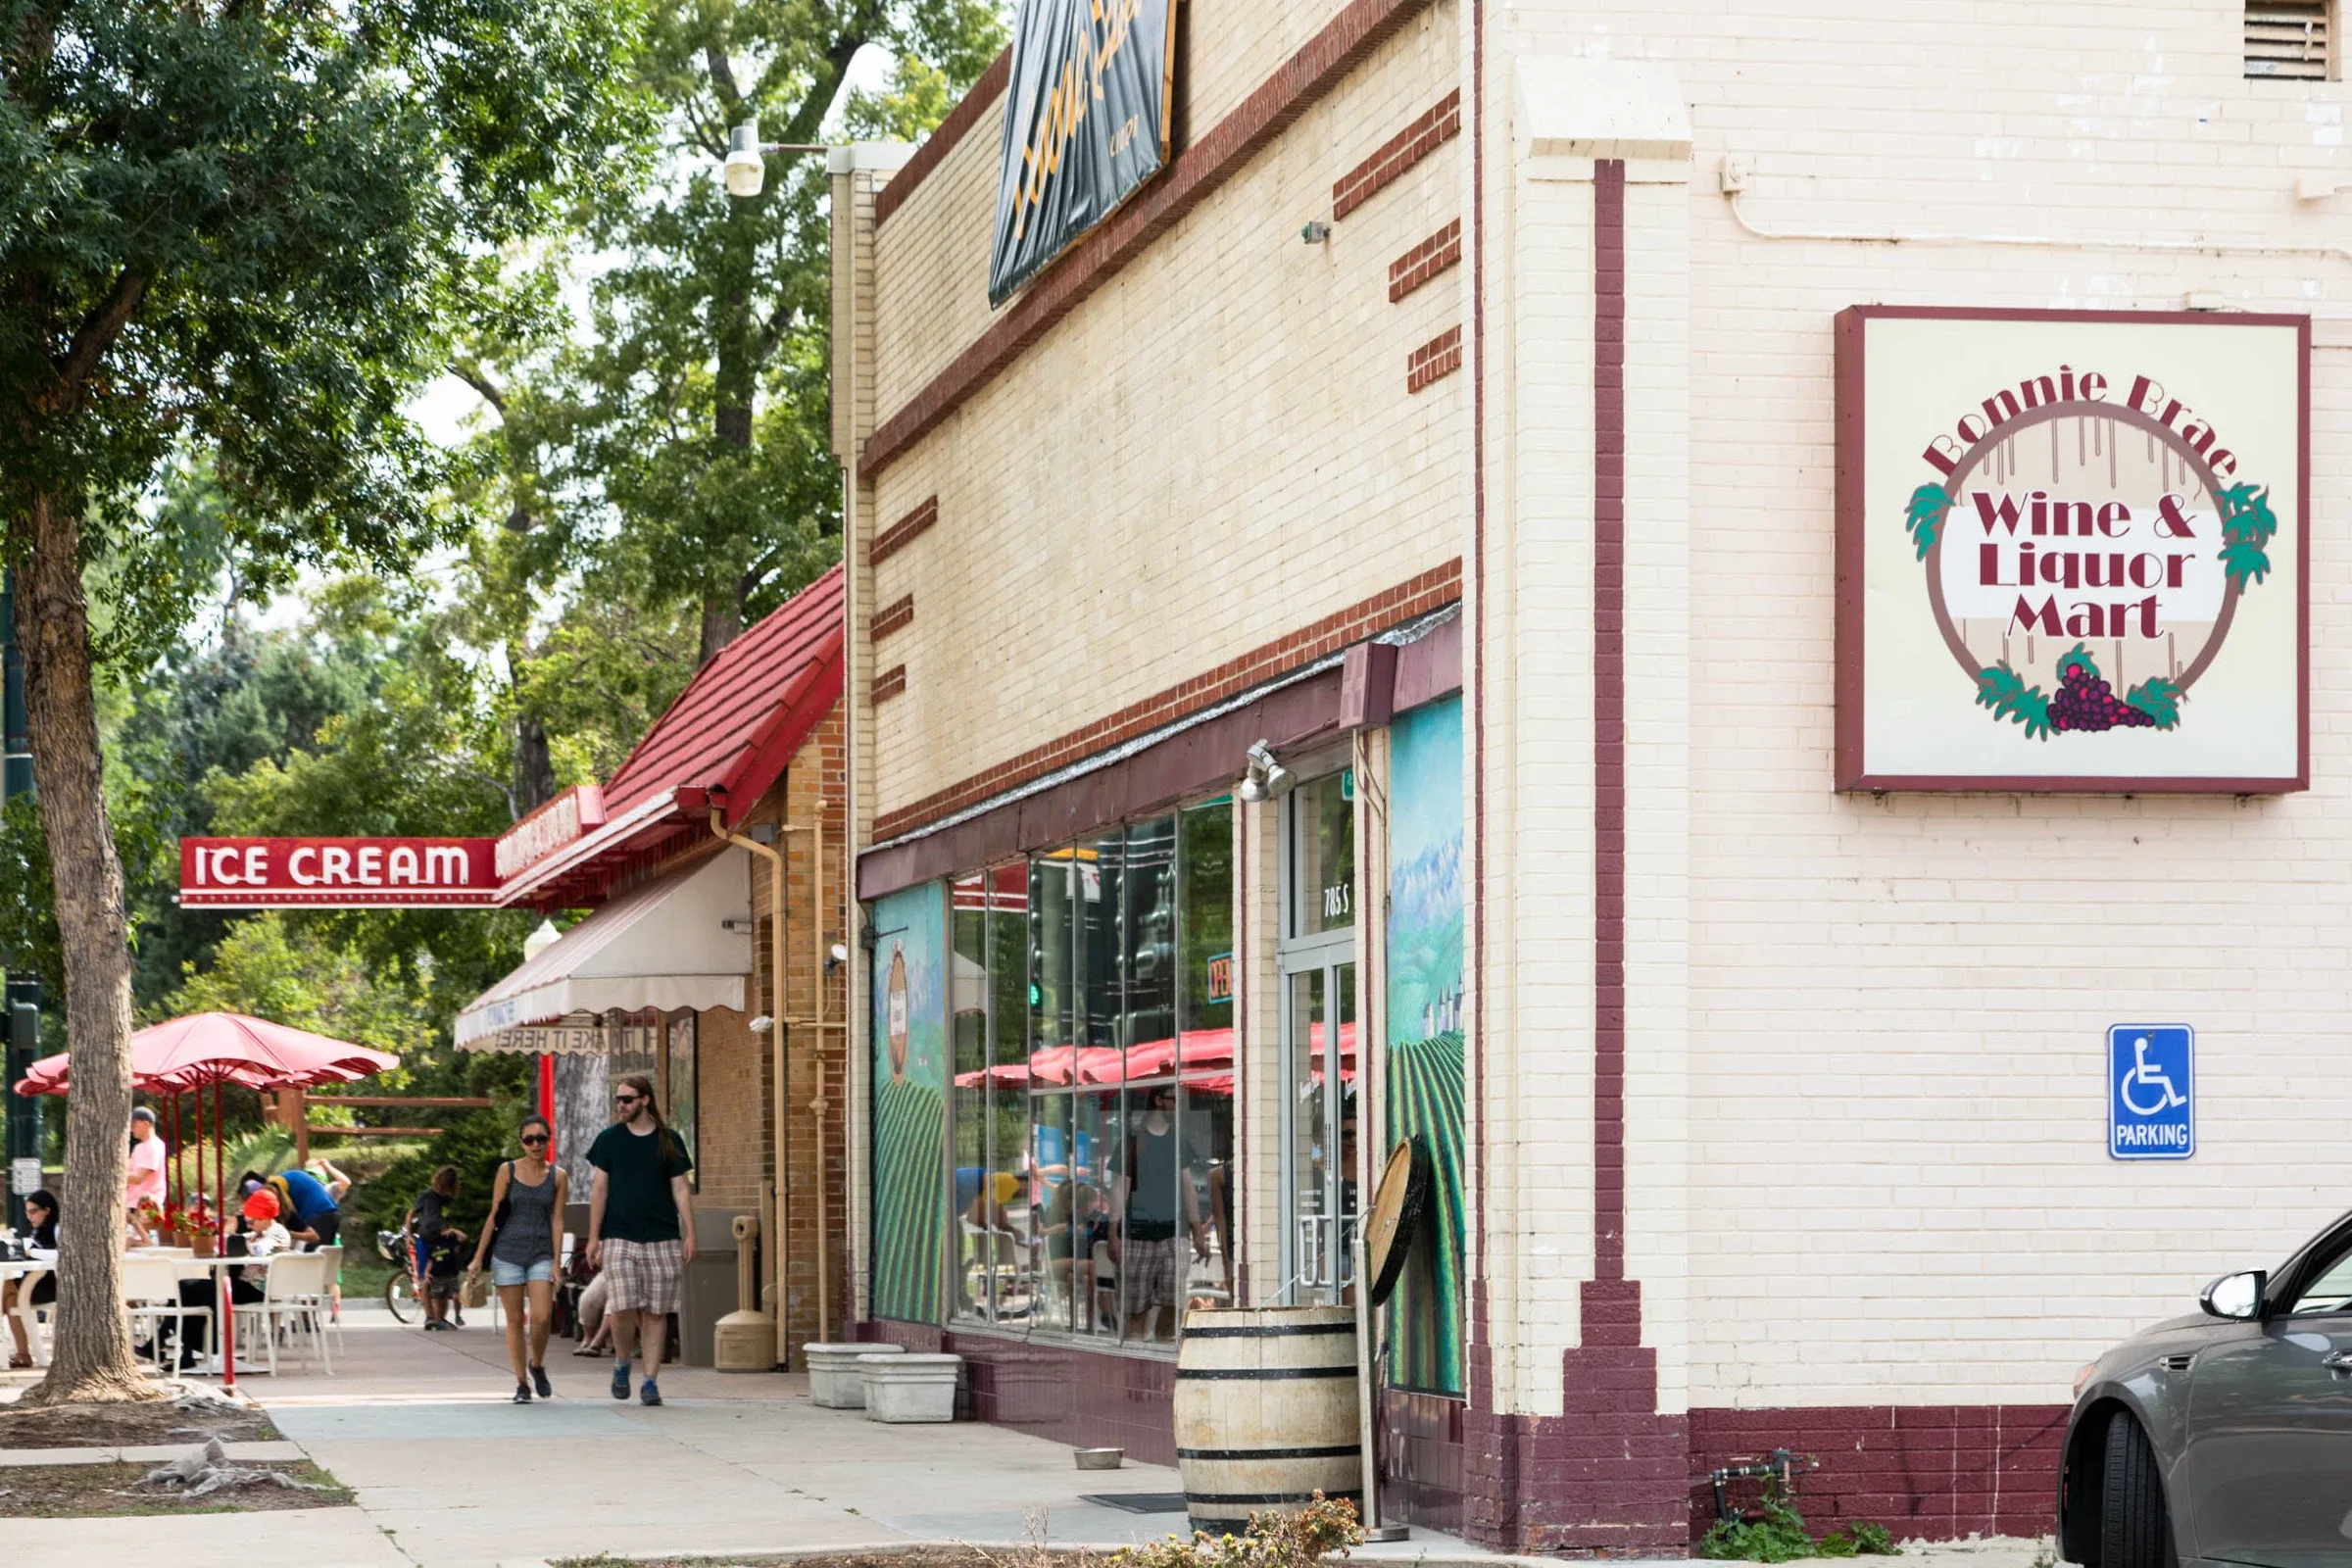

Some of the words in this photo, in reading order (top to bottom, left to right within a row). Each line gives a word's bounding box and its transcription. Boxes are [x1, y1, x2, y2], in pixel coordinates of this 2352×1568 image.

[1922, 365, 2108, 477] Bonnie
[2126, 374, 2237, 480] Brae
[1972, 491, 2132, 538] Wine
[2153, 493, 2197, 539] &
[1980, 541, 2197, 589] Liquor
[2008, 593, 2165, 639] Mart
[195, 846, 269, 886] ICE
[288, 846, 470, 886] CREAM
[1324, 885, 1342, 917] 785
[2116, 1123, 2188, 1146] PARKING
